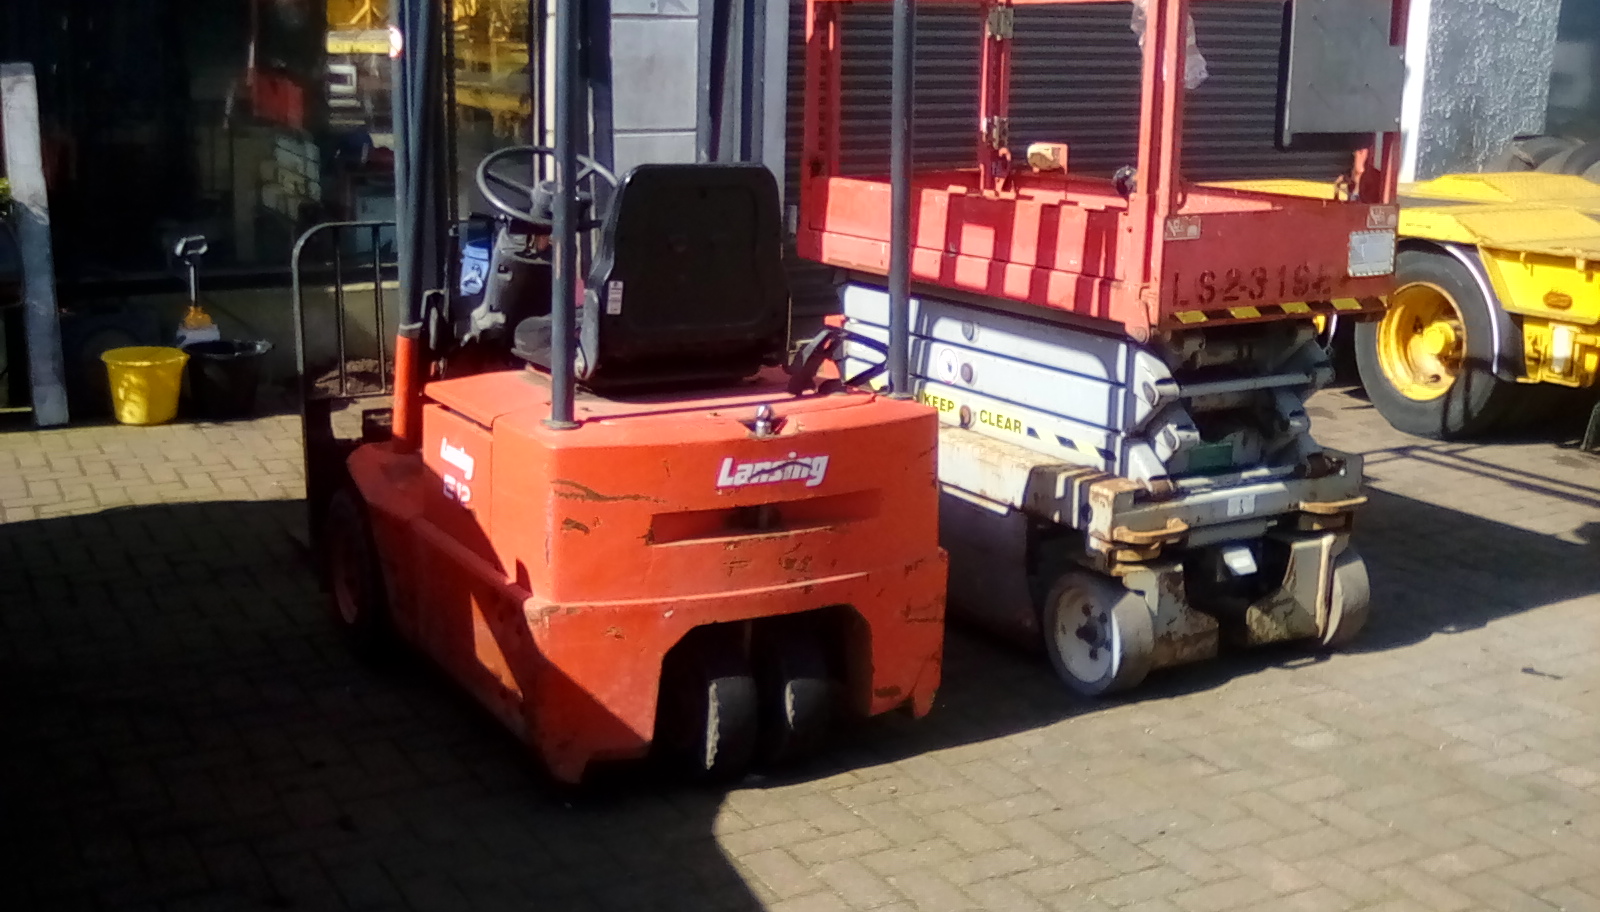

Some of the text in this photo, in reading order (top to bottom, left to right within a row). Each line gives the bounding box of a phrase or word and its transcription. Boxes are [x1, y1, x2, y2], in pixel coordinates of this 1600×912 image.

[924, 393, 1022, 433] KEEP CLEAR
[716, 451, 829, 487] Lansing
